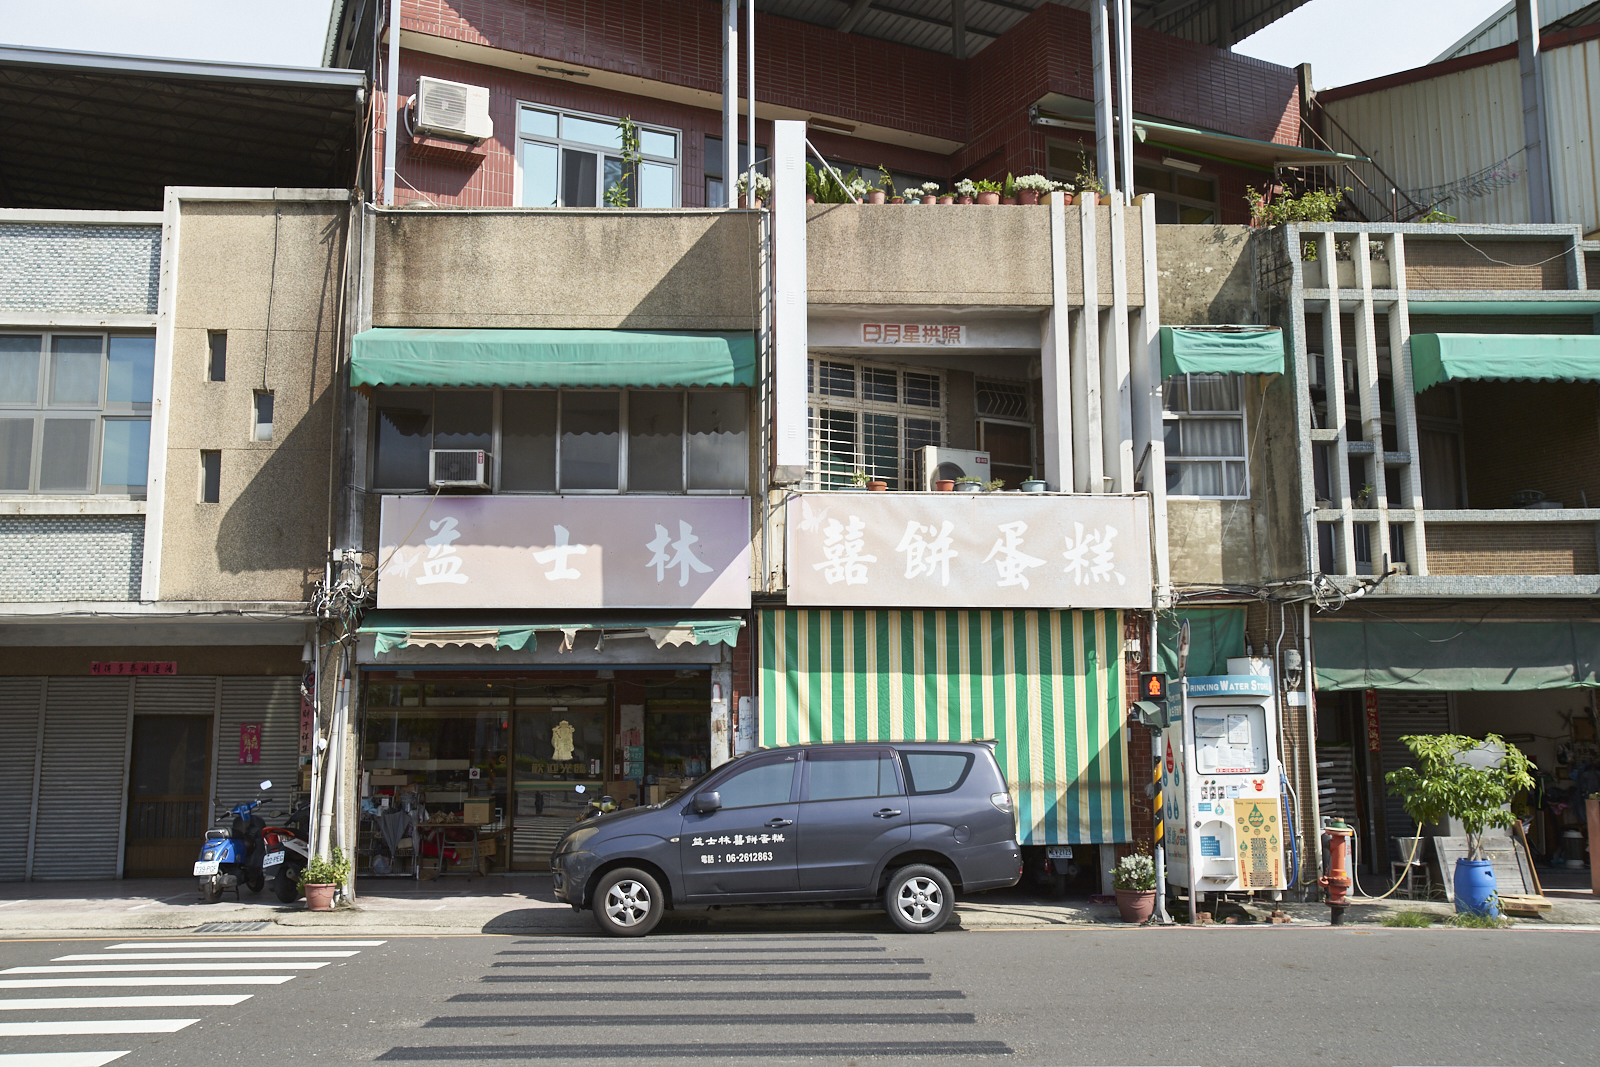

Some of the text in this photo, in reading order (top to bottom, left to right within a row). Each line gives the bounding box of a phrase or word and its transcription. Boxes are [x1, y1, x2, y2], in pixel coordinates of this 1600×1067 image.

[863, 324, 961, 344] 日月星拱照
[415, 516, 714, 588] 益士林
[812, 515, 1126, 591] 囍餅蛋糕
[1220, 680, 1249, 691] WATER
[725, 851, 773, 863] 06-2612863
